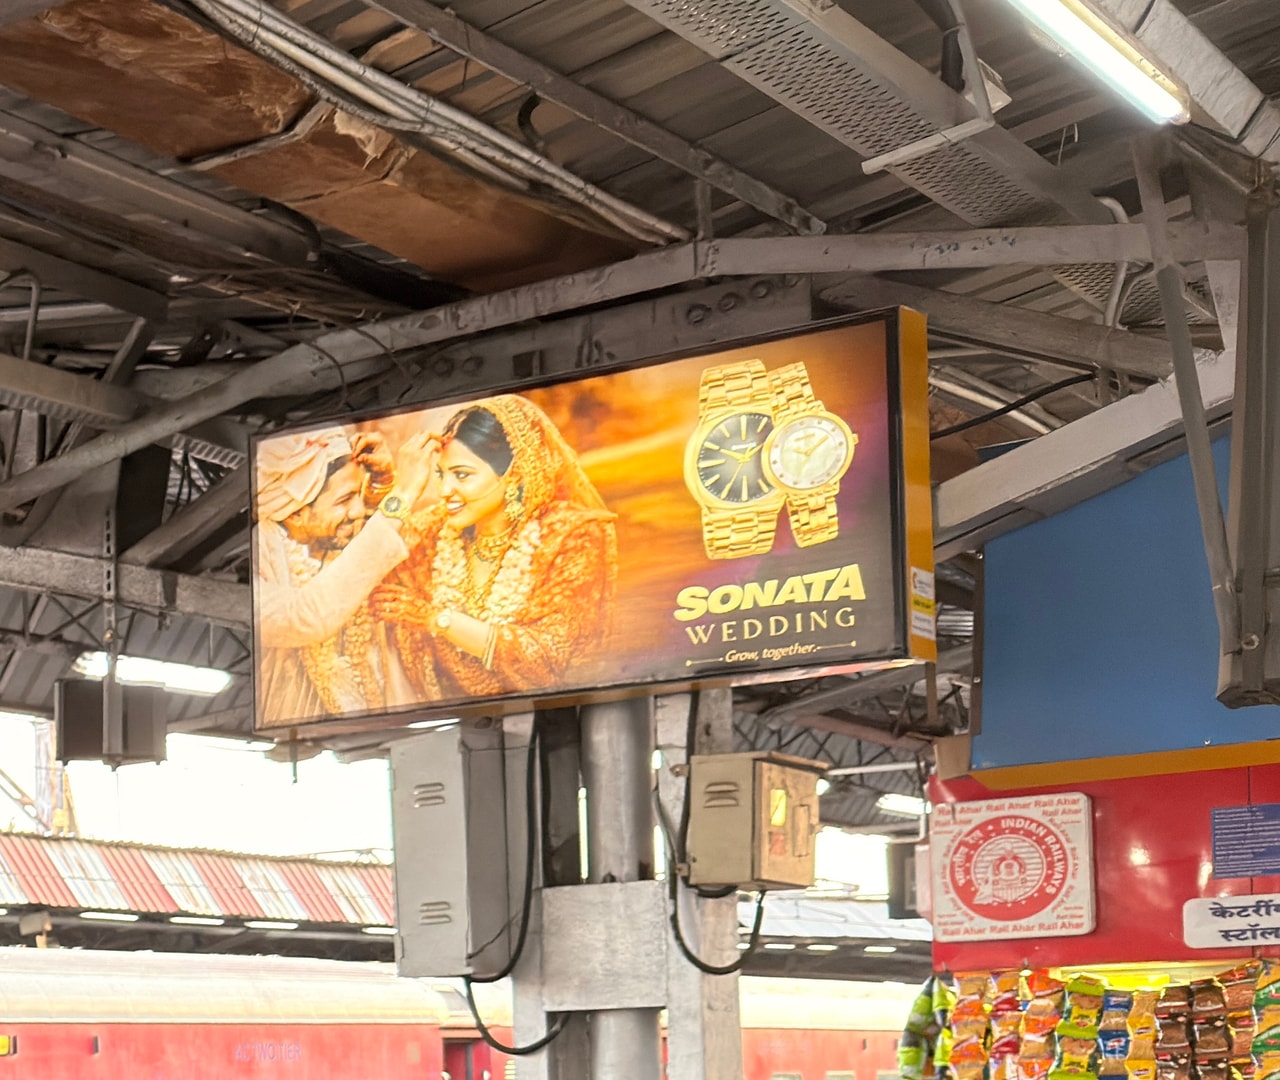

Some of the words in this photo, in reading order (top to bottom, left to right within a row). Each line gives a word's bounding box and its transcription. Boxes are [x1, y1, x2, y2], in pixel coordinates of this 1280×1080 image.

[673, 563, 866, 622] SONATA
[685, 606, 856, 645] WEDDING
[724, 649, 759, 663] Grow,
[762, 642, 817, 660] together.
[1000, 818, 1047, 837] INDIAN
[1044, 835, 1065, 895] RAILWAYS
